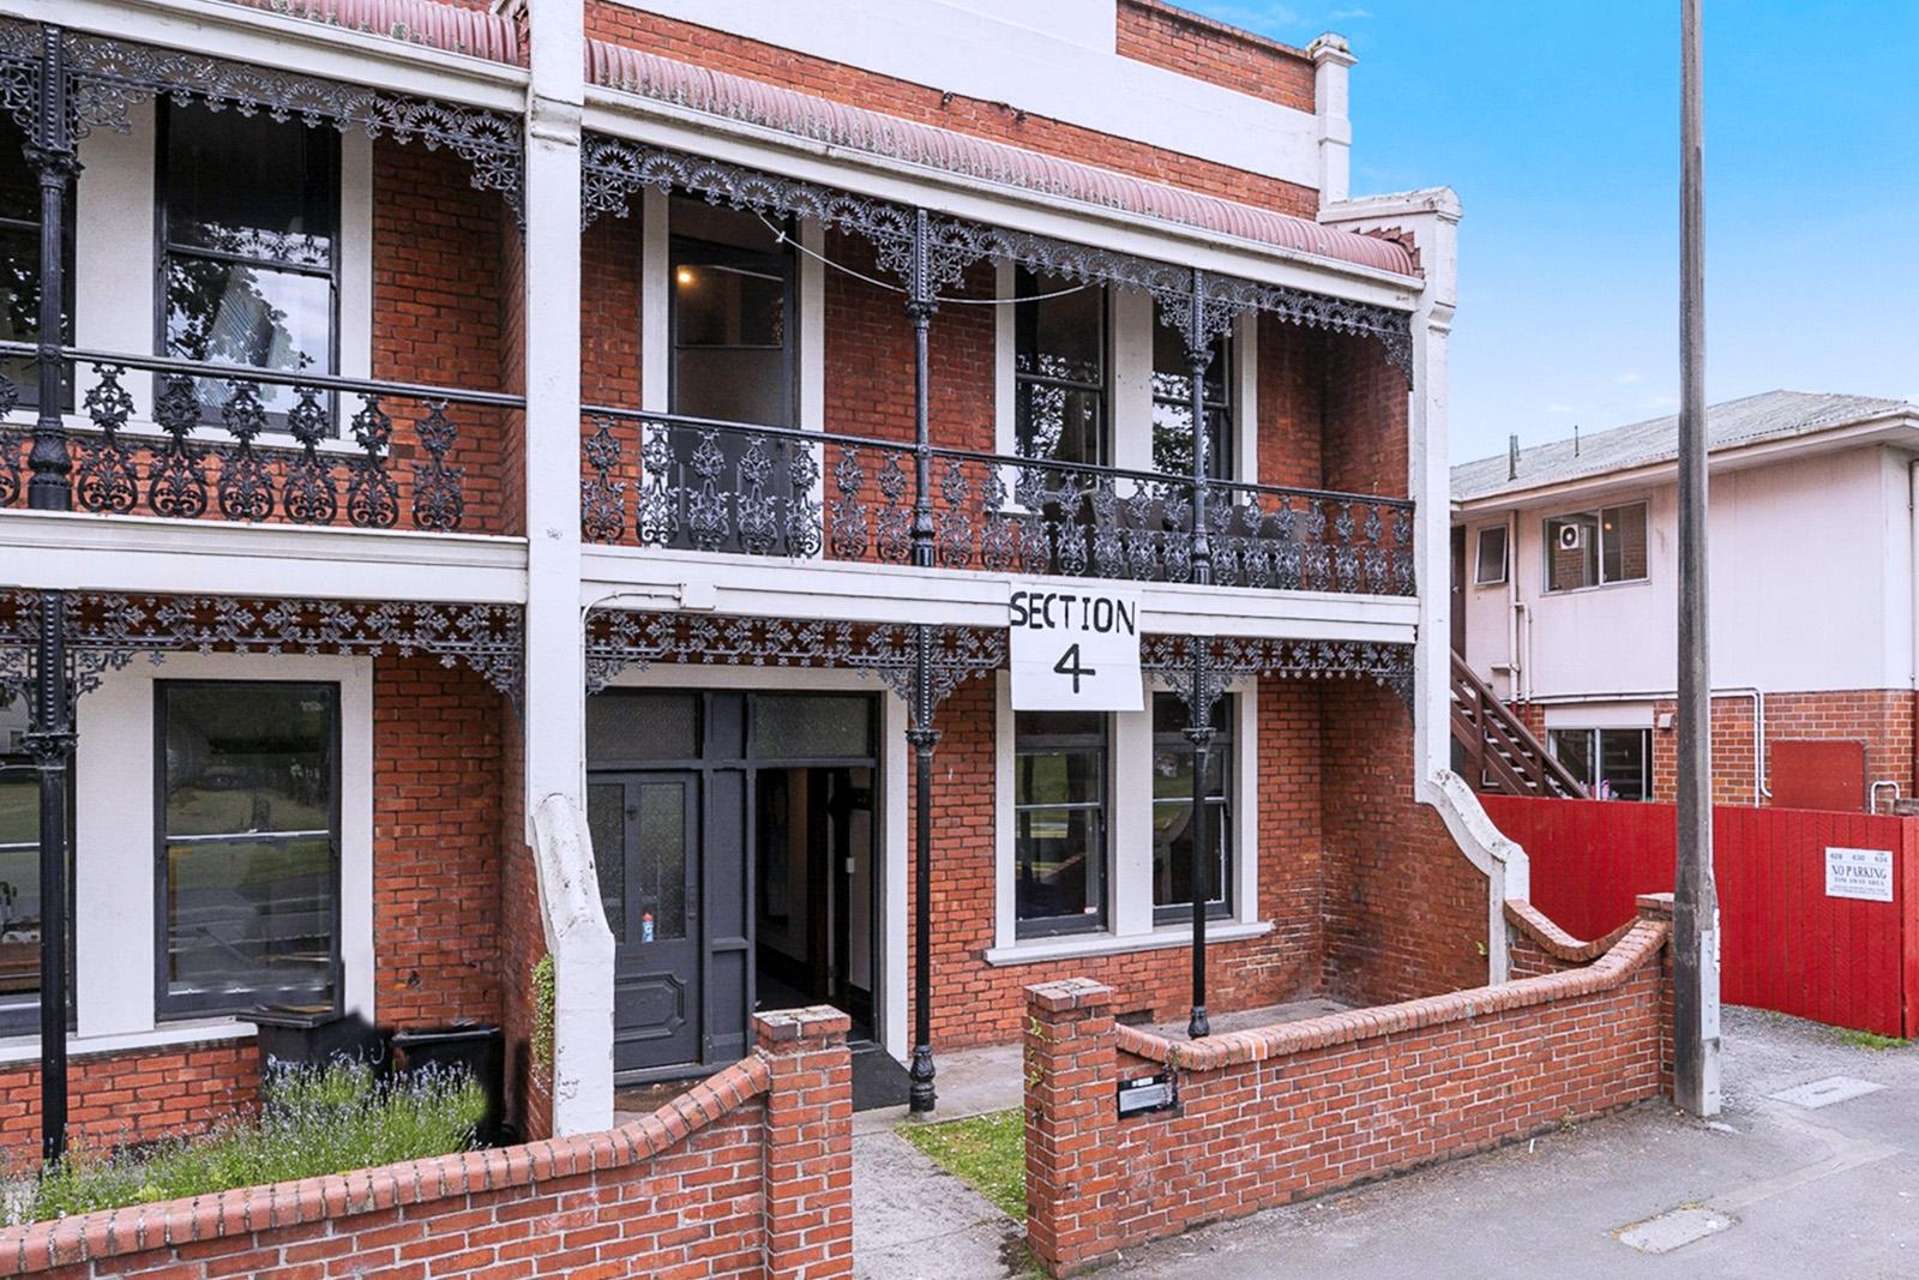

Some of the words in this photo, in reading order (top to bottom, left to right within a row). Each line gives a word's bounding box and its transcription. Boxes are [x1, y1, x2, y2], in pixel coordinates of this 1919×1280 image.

[1010, 591, 1135, 636] SECTION
[1053, 643, 1096, 694] 4
[1832, 864, 1845, 876] NO
[1846, 865, 1887, 880] PARKING
